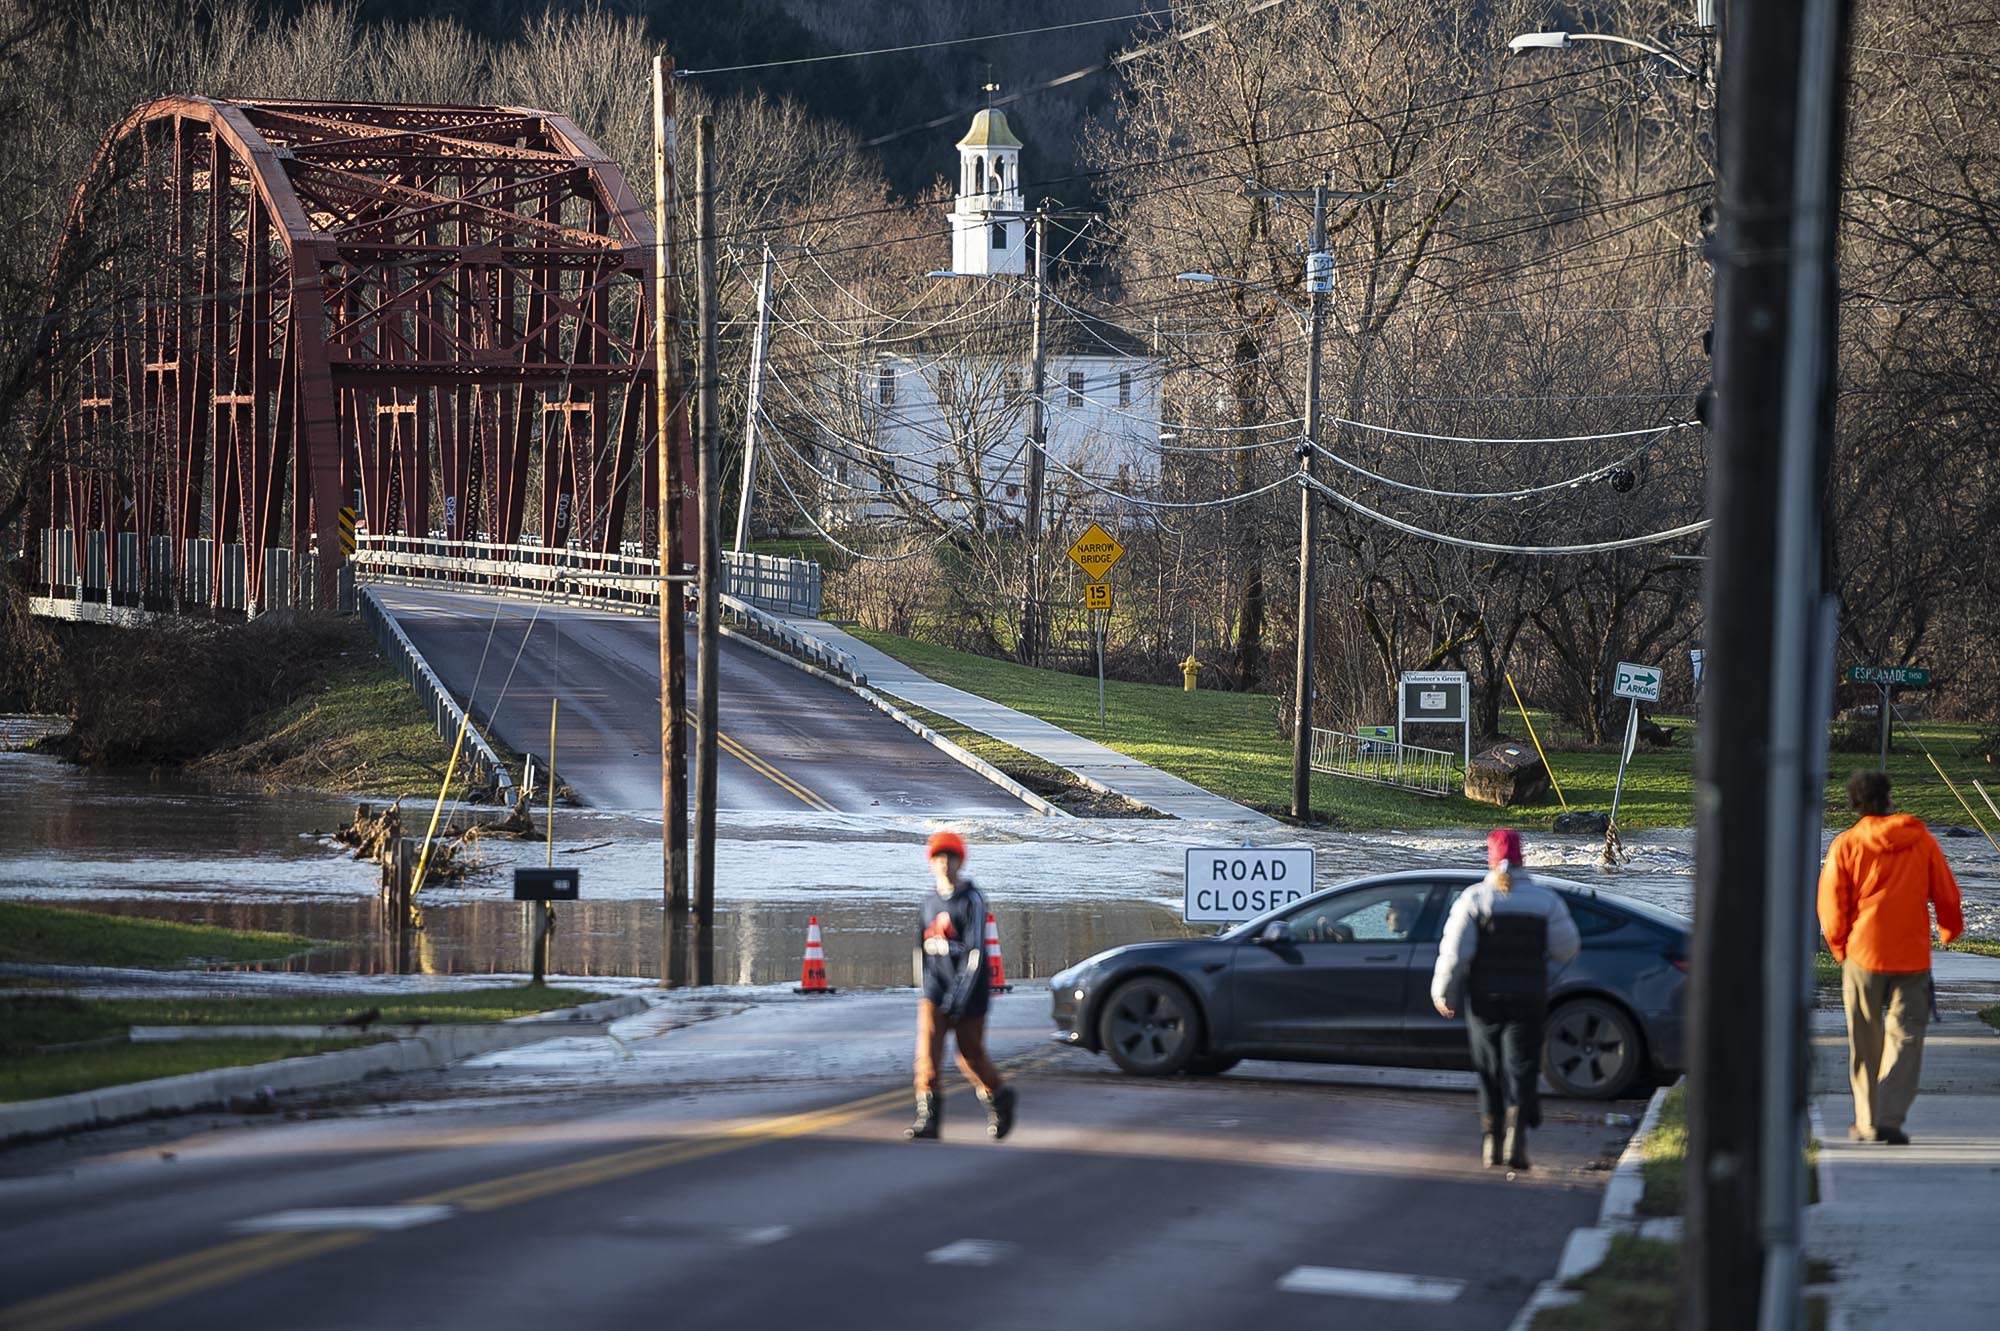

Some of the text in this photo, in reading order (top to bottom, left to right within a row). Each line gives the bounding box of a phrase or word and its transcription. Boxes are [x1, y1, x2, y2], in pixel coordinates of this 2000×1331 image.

[1077, 543, 1114, 553] NARROW
[1081, 554, 1112, 564] BRIDGE
[1090, 586, 1106, 599] 15
[1213, 859, 1287, 881] ROAD
